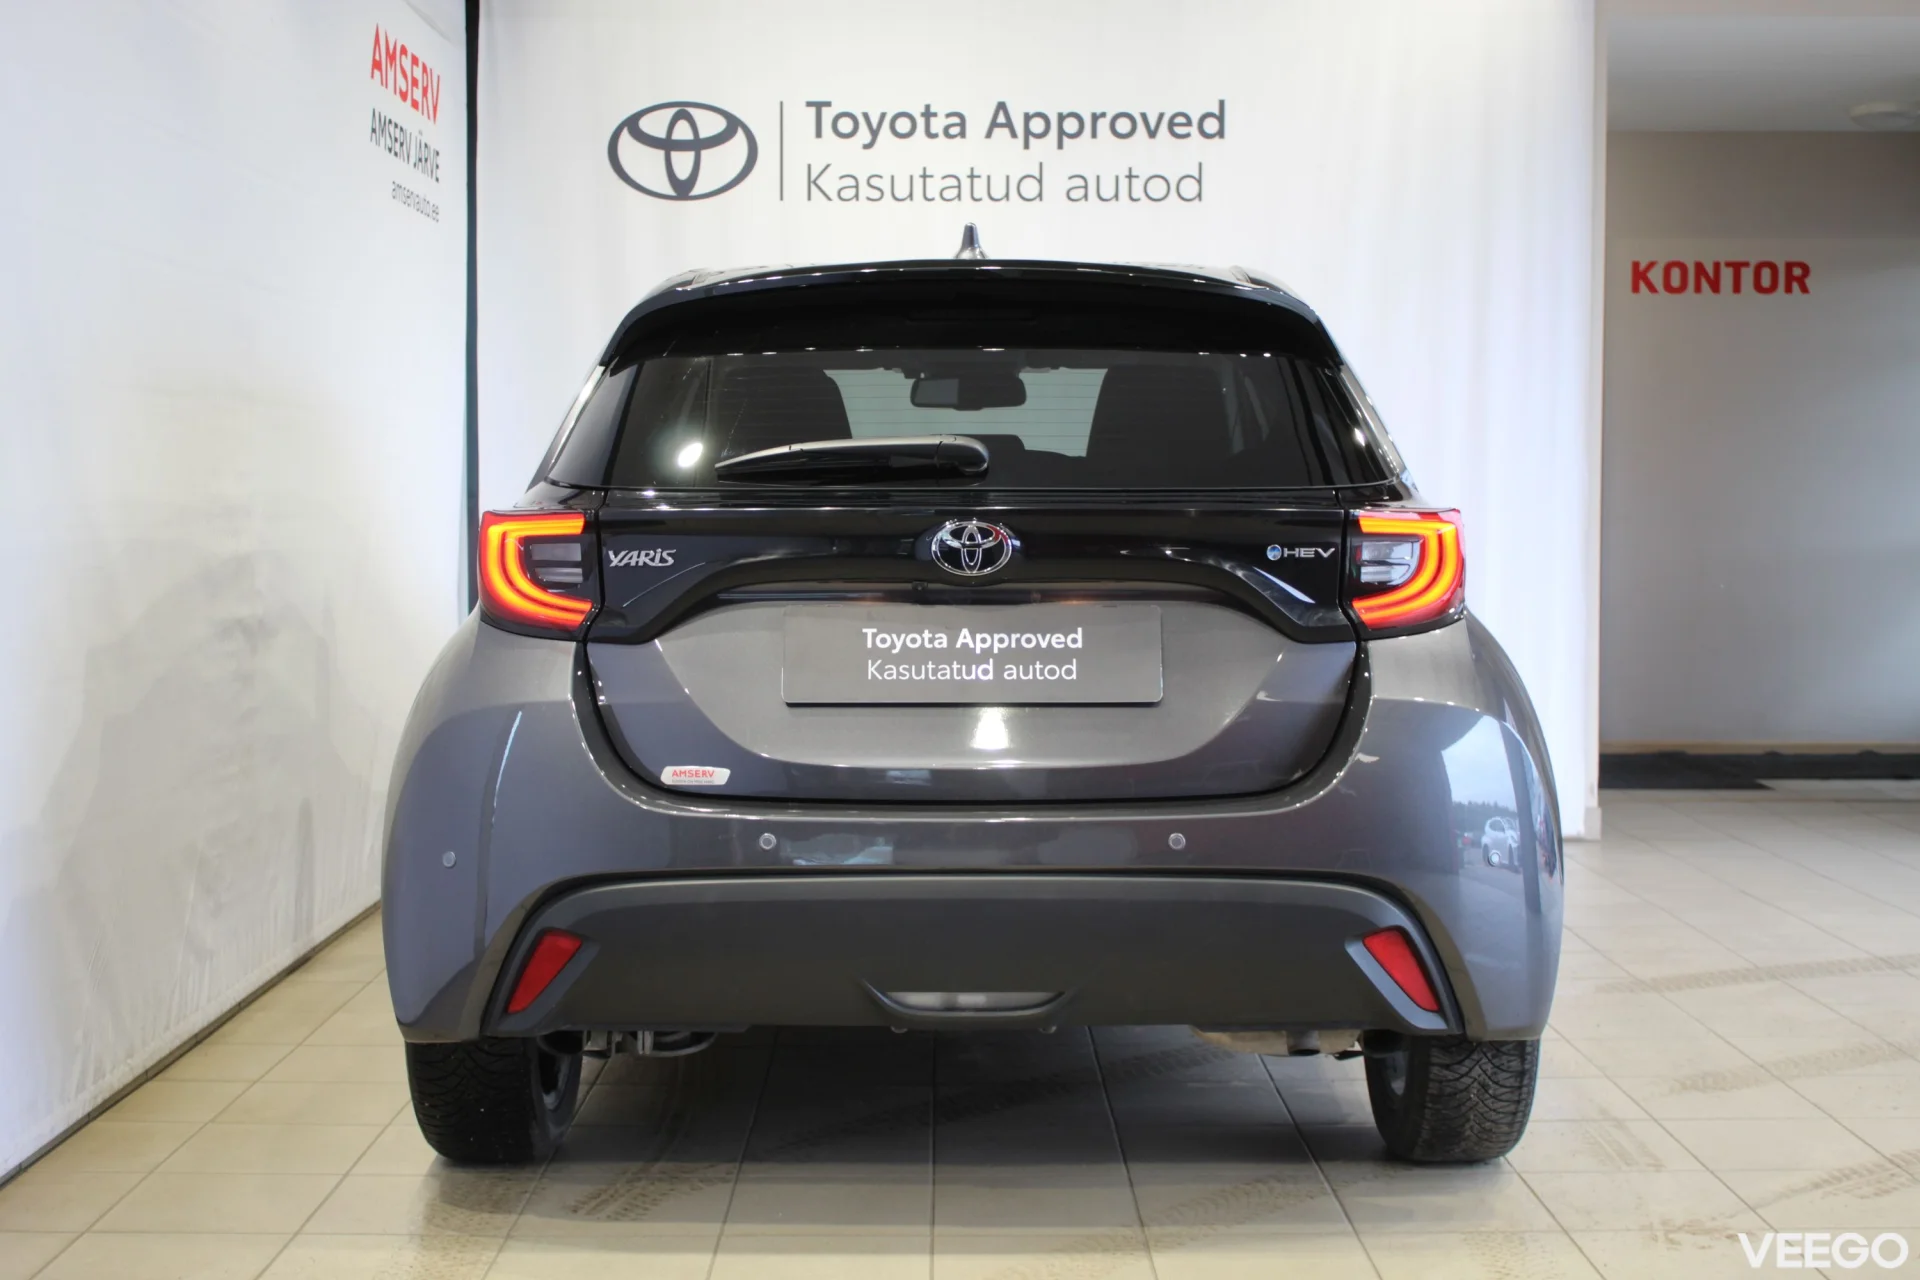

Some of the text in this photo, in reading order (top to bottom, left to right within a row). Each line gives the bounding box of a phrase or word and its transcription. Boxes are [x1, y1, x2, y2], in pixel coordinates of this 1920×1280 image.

[370, 22, 441, 125] AMSERV
[805, 99, 1226, 150] Toyota Approved
[370, 107, 440, 184] AMSERV JÄRVE
[806, 161, 1203, 202] Kasutatud autod
[391, 180, 440, 223] amservauto.ee
[1630, 260, 1811, 295] KONTOR
[1283, 547, 1336, 558] HEV
[862, 627, 1083, 654] Toyota Approved
[867, 658, 1077, 681] Kasutatud autod
[671, 769, 715, 778] AMSERV
